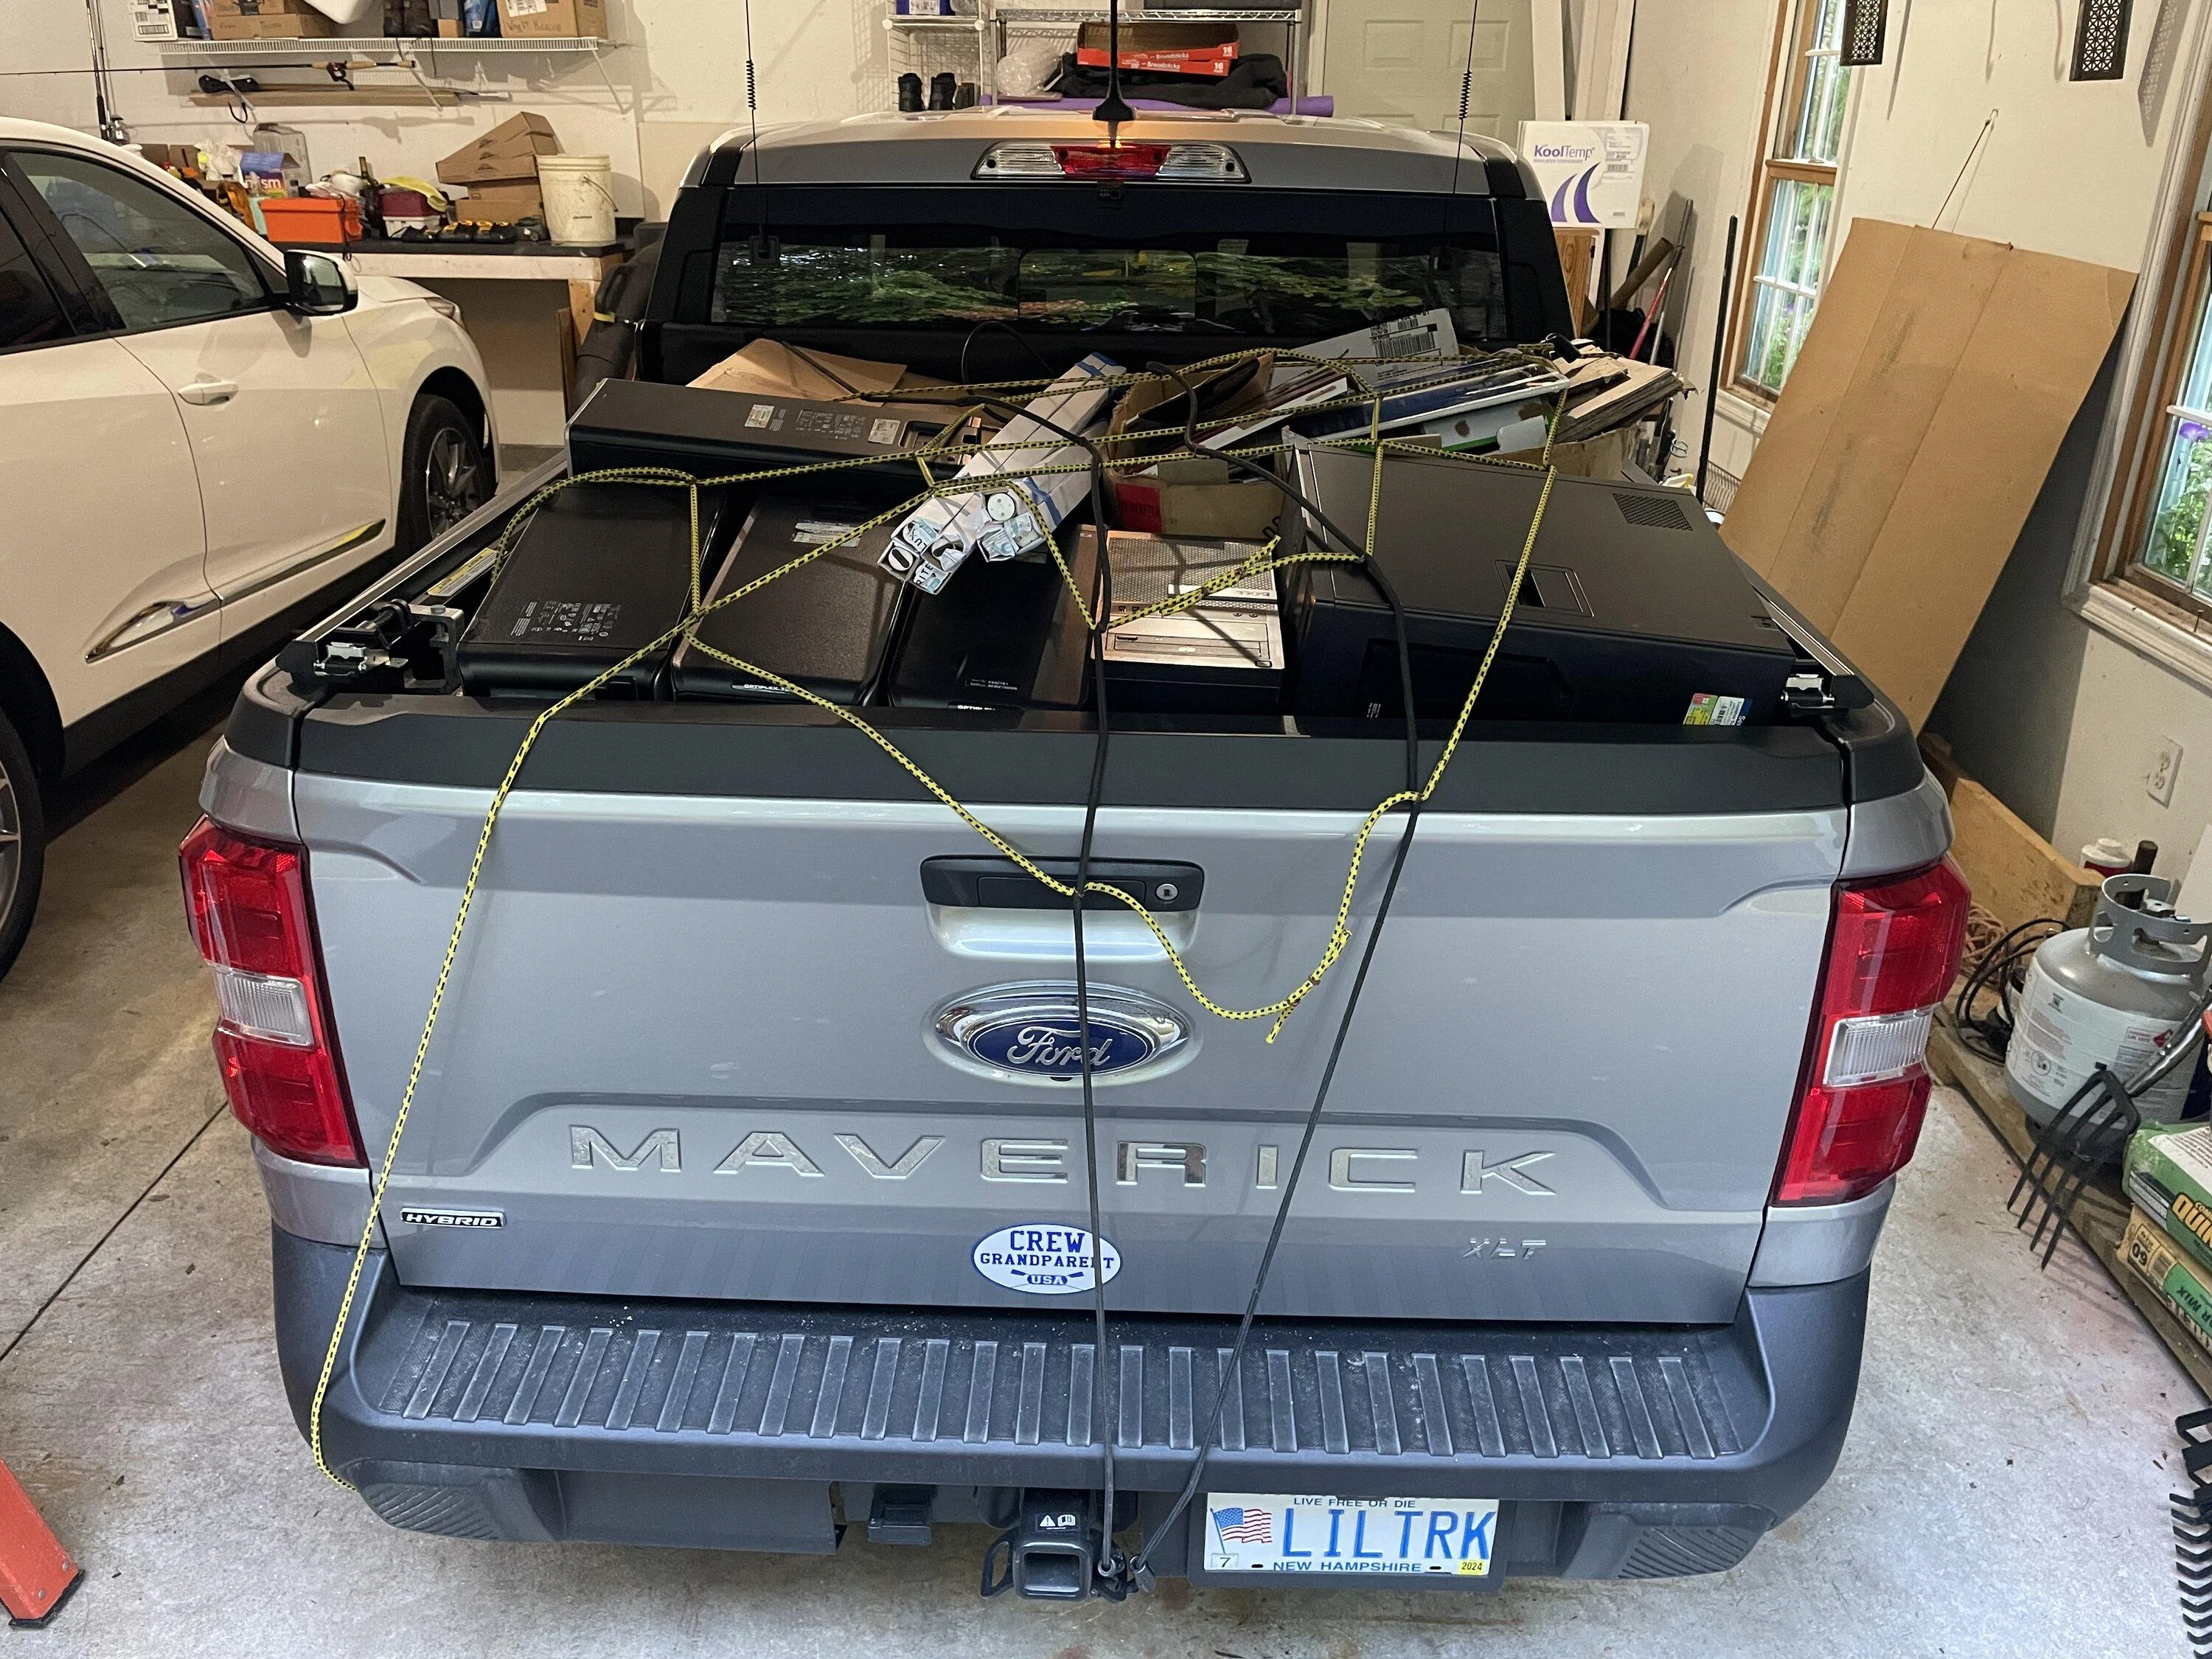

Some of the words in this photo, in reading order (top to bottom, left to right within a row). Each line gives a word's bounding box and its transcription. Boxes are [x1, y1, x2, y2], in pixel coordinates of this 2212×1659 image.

[1006, 1026, 1113, 1066] Ford
[568, 1124, 1557, 1196] MAVERICK
[406, 1214, 498, 1226] HYBRID
[1010, 1230, 1085, 1253] CREW
[980, 1253, 1115, 1270] GRANDPARET
[1031, 1275, 1065, 1285] USA
[1294, 1498, 1322, 1506] LIVE
[1329, 1499, 1363, 1507] FREE
[1368, 1500, 1388, 1508] OR
[1394, 1500, 1416, 1509] DIE
[1282, 1508, 1496, 1559] LILTRK
[1220, 1557, 1231, 1568] 7
[1273, 1562, 1312, 1571] NEW
[1321, 1562, 1422, 1572] HAMPSHIRE
[1461, 1562, 1483, 1571] 2024
